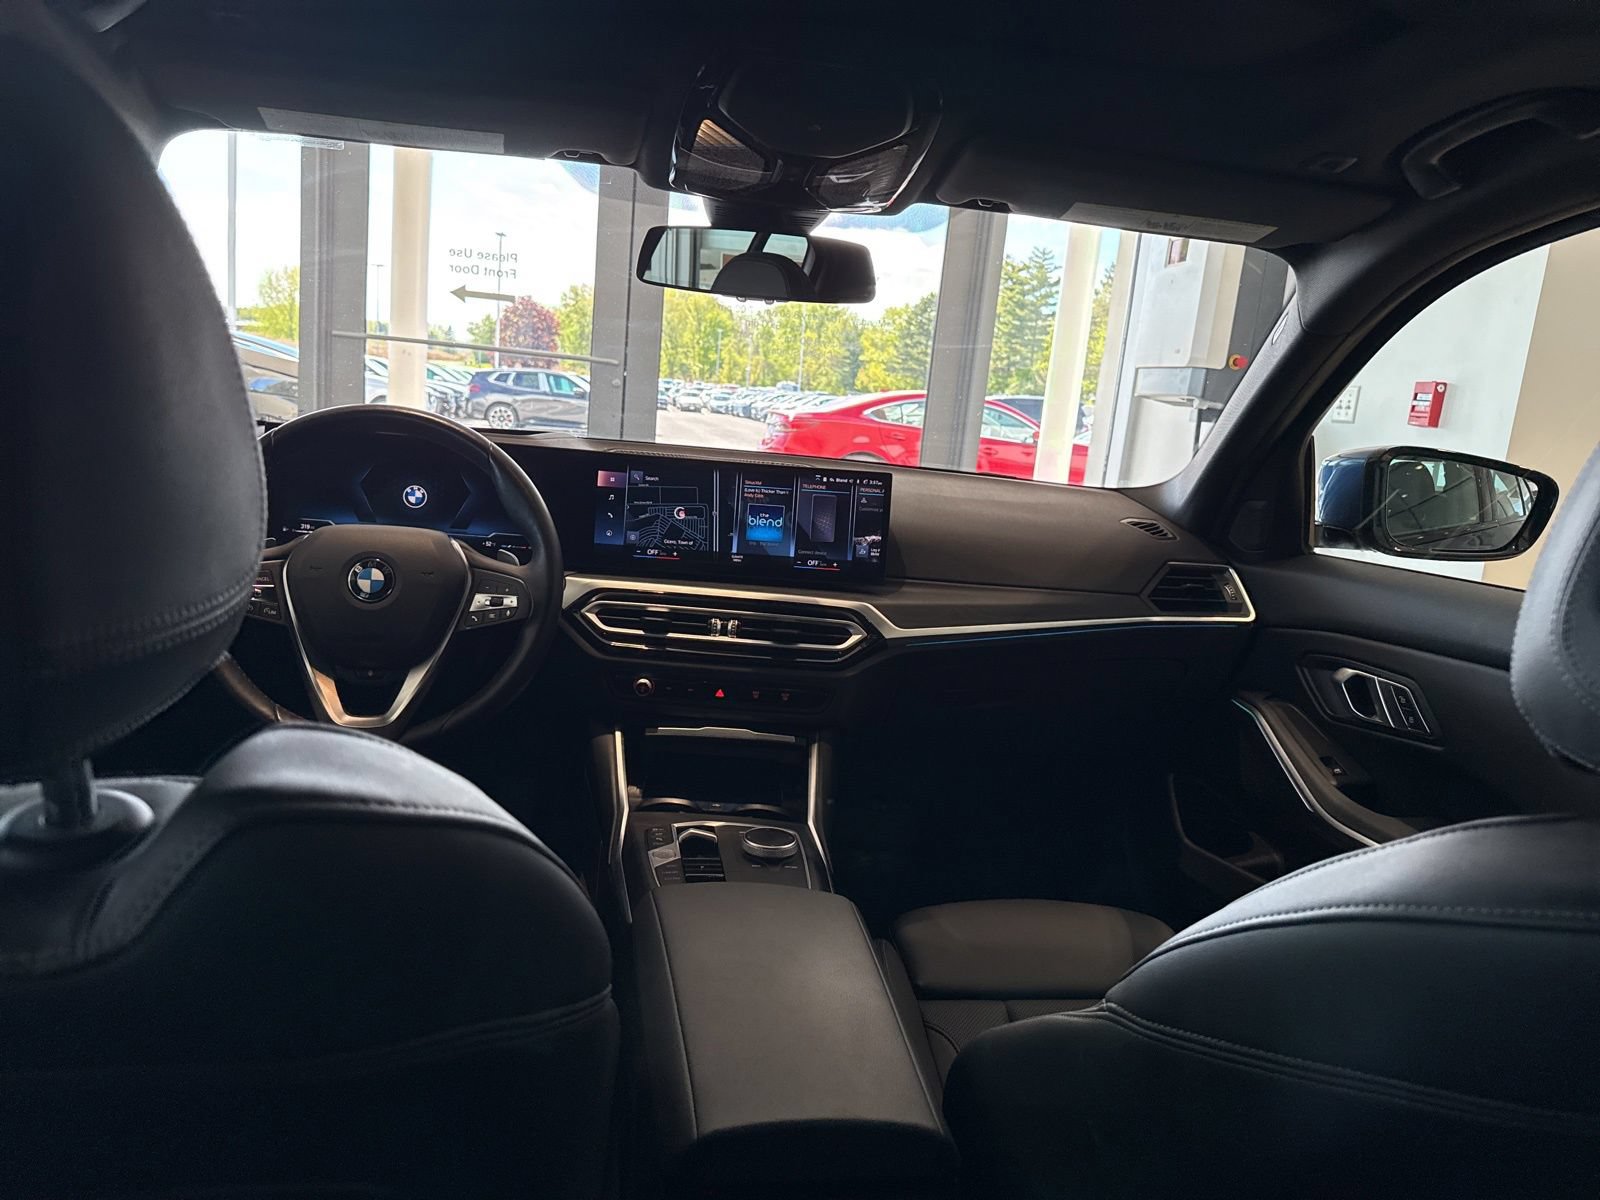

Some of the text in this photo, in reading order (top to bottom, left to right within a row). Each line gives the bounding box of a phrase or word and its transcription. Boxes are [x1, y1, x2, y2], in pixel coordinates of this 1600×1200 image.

[748, 514, 783, 528] blend
[646, 548, 659, 556] OFF
[807, 559, 819, 567] OFF
